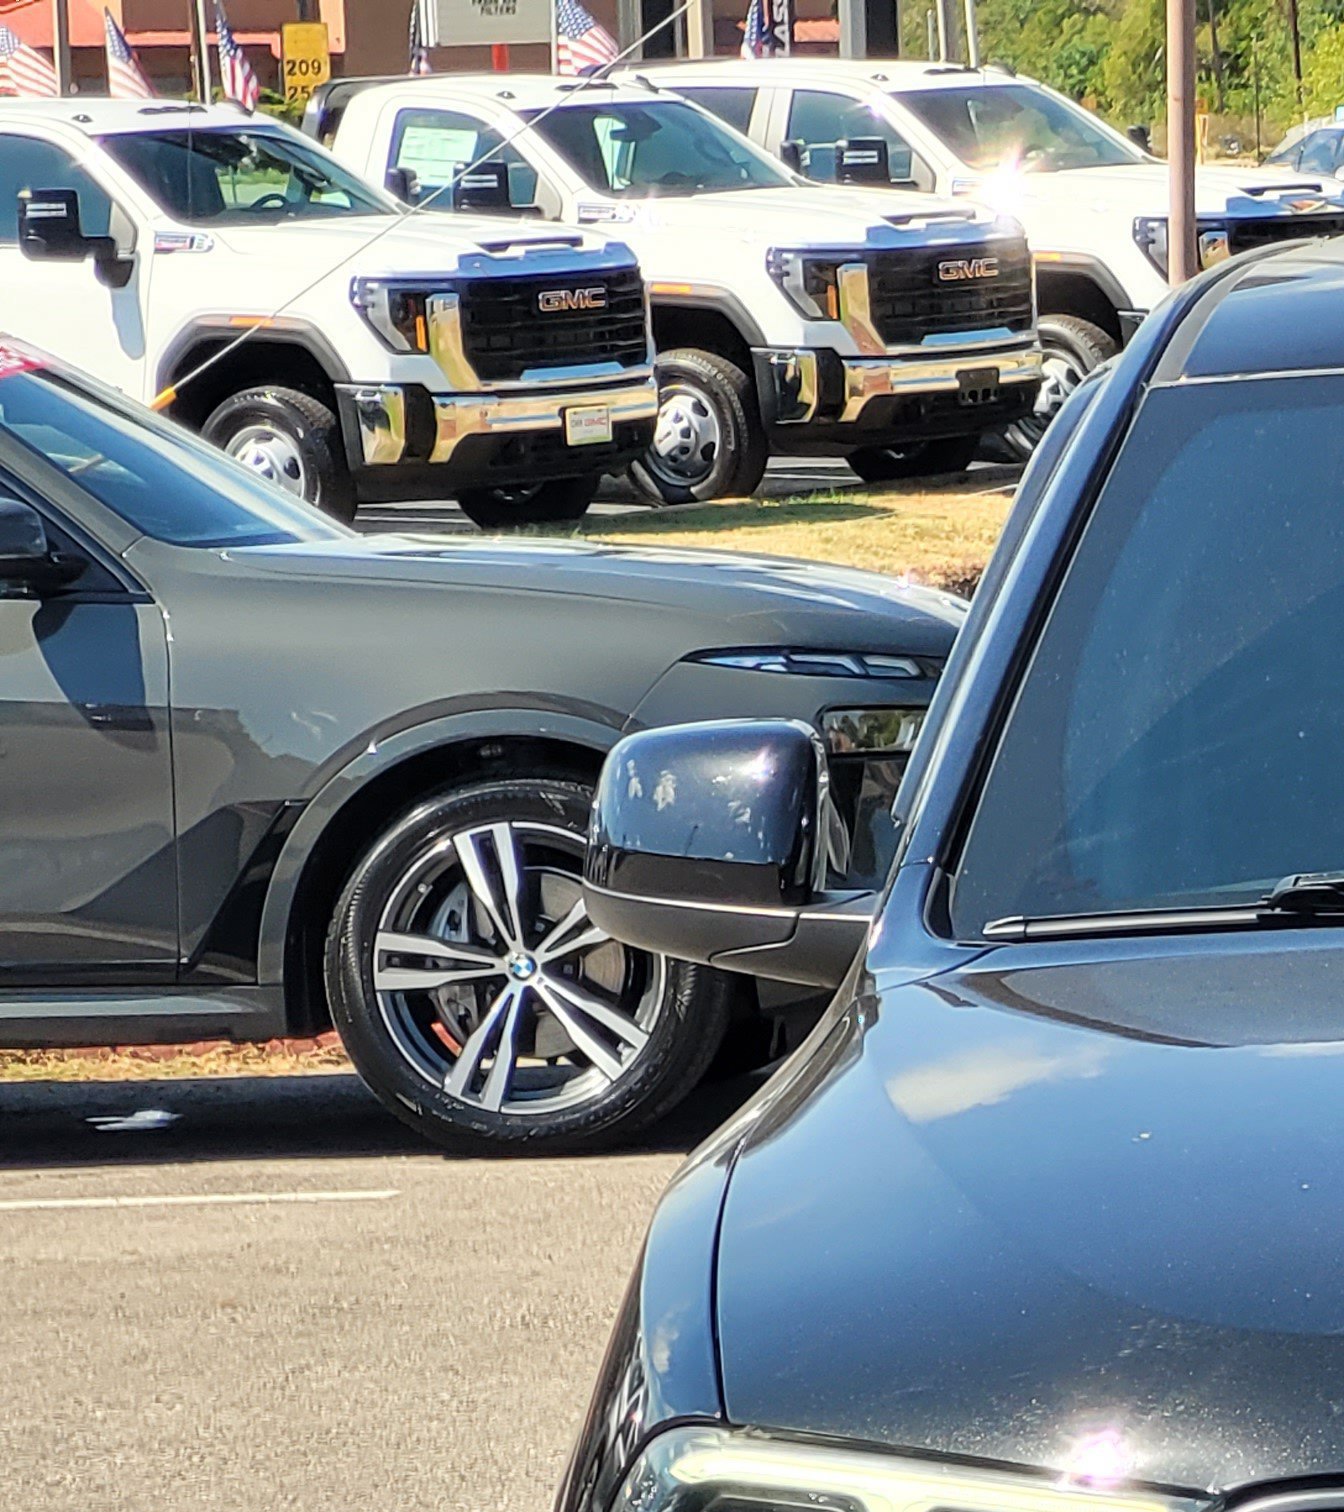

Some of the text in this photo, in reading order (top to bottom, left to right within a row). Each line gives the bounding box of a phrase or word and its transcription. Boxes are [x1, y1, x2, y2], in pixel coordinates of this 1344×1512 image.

[286, 59, 321, 76] 209
[288, 85, 318, 101] 25
[938, 258, 998, 280] GMC
[538, 287, 606, 311] GMC
